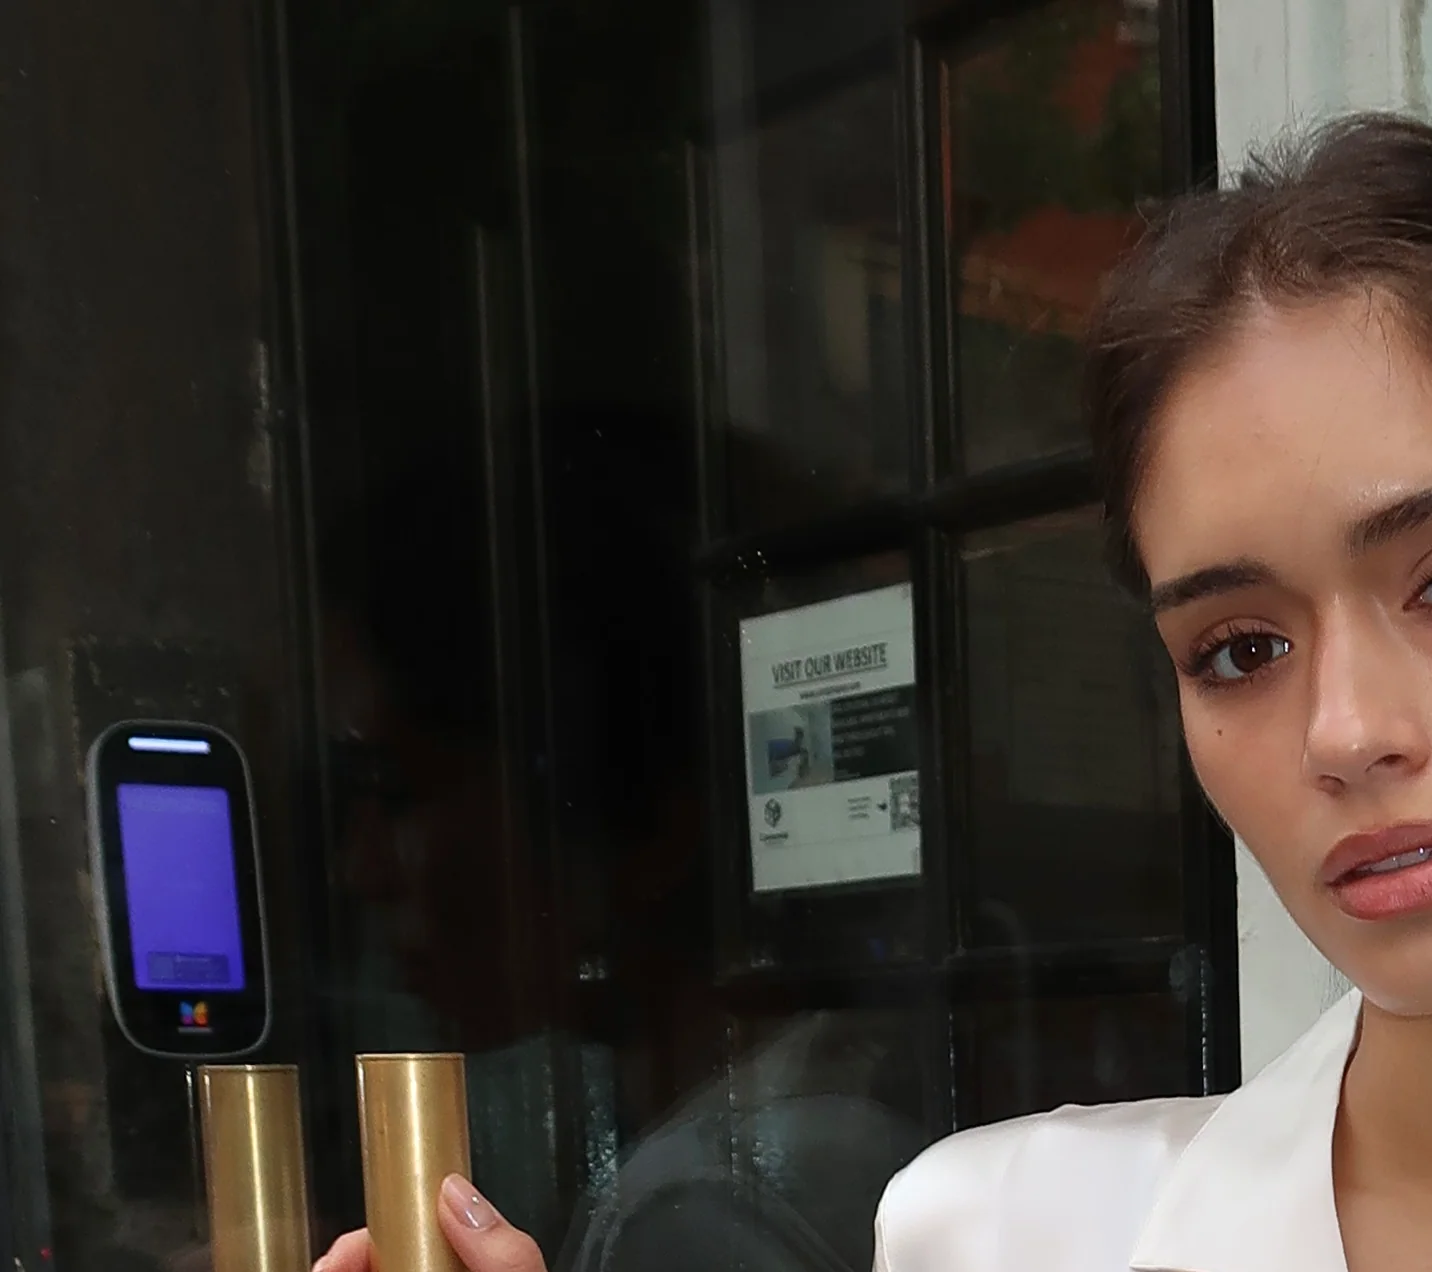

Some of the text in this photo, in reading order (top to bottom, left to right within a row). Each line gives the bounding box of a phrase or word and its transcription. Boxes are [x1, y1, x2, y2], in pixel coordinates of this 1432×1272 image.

[772, 642, 888, 683] VISIT OUR WEBSITE
